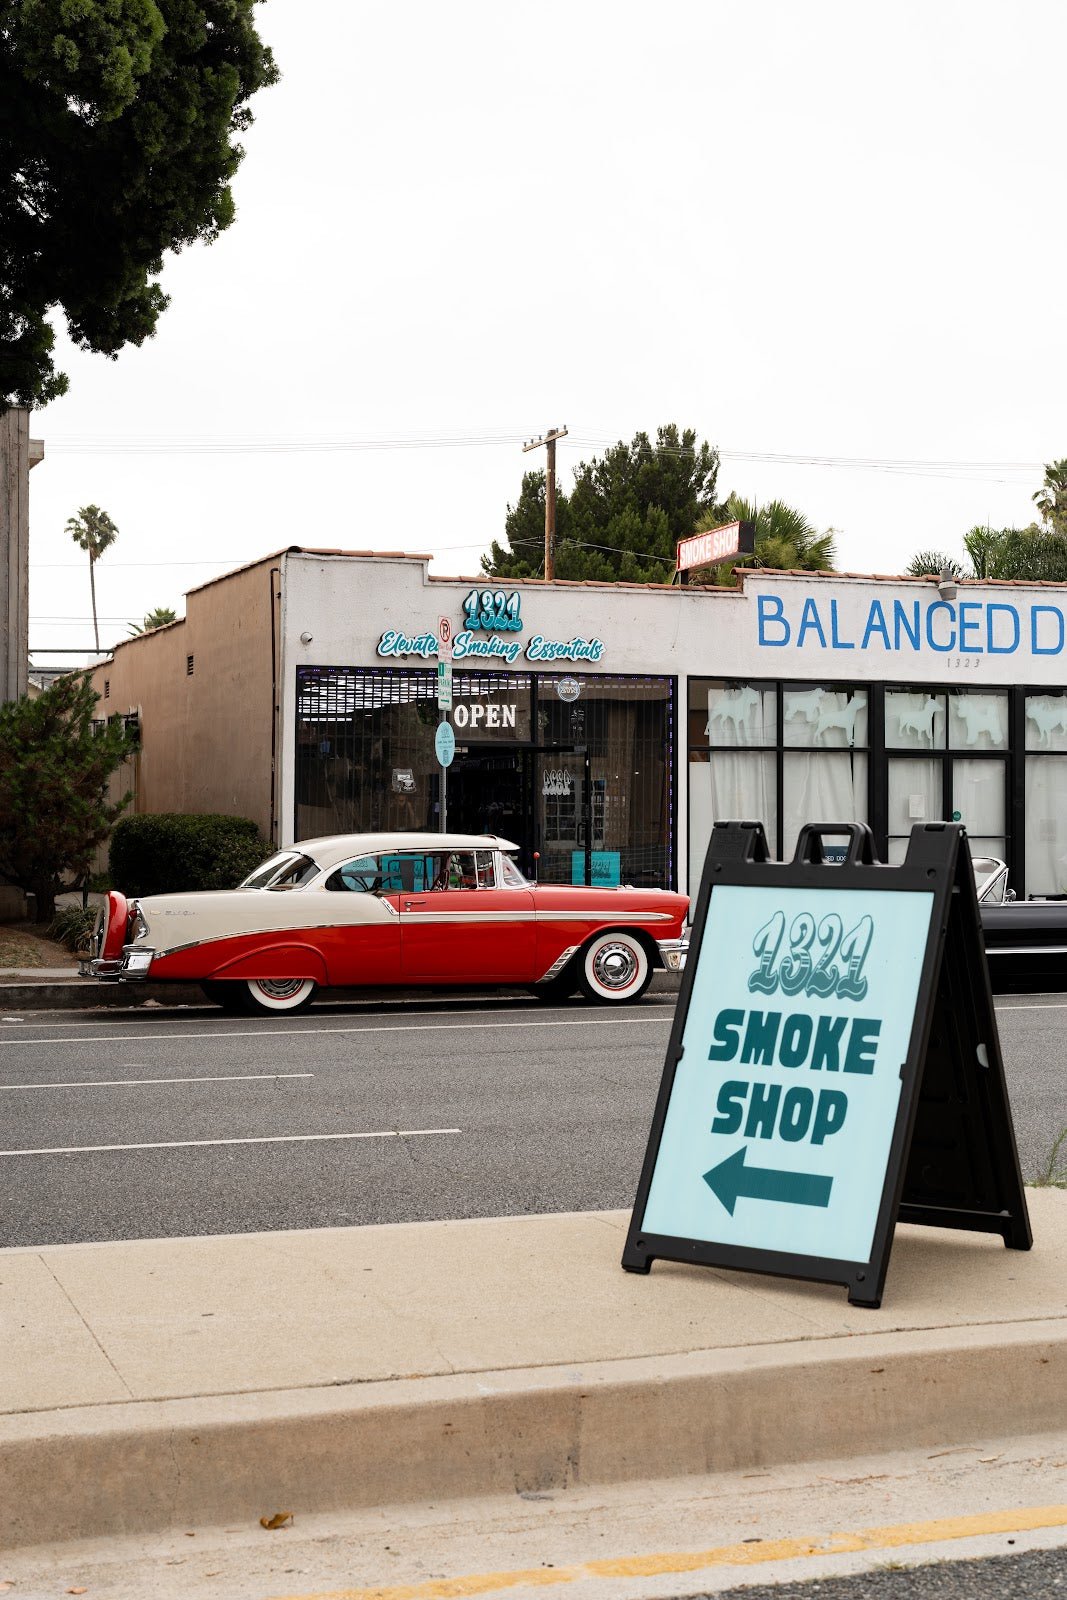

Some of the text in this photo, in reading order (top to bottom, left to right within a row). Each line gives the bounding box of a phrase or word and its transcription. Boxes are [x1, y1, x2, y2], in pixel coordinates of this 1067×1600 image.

[680, 525, 739, 567] SMOKE SHOP
[462, 589, 523, 632] 1321
[757, 594, 1020, 654] BALANCED
[452, 630, 523, 663] Smoking
[526, 635, 605, 661] Essentials
[947, 658, 980, 668] 1323
[453, 704, 517, 728] OPEN
[748, 910, 874, 1002] 1321
[708, 1008, 882, 1075] SMOKE
[711, 1080, 849, 1145] SHOP
